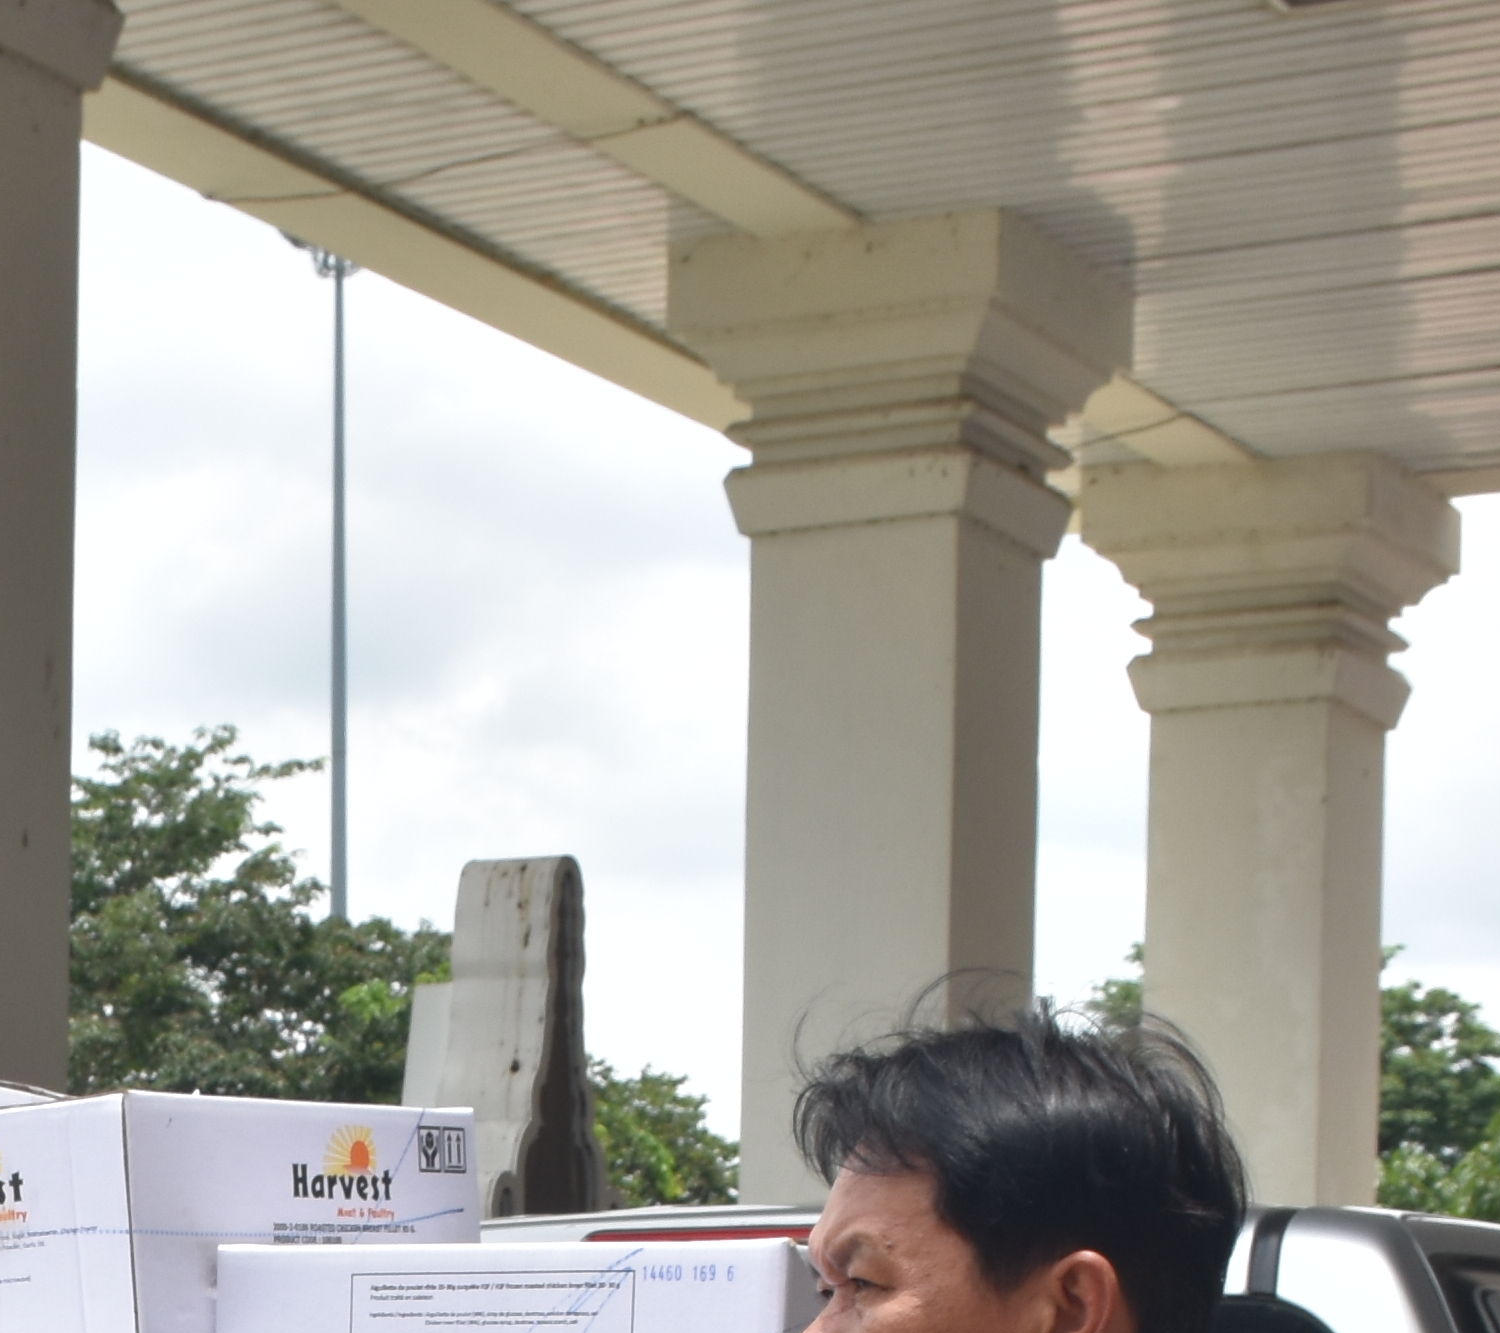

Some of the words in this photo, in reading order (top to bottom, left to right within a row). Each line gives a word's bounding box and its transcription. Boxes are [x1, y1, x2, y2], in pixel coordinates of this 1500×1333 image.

[292, 1163, 392, 1200] Harvest
[643, 1265, 682, 1281] 14460
[693, 1264, 716, 1282] 169
[727, 1265, 734, 1282] 6
